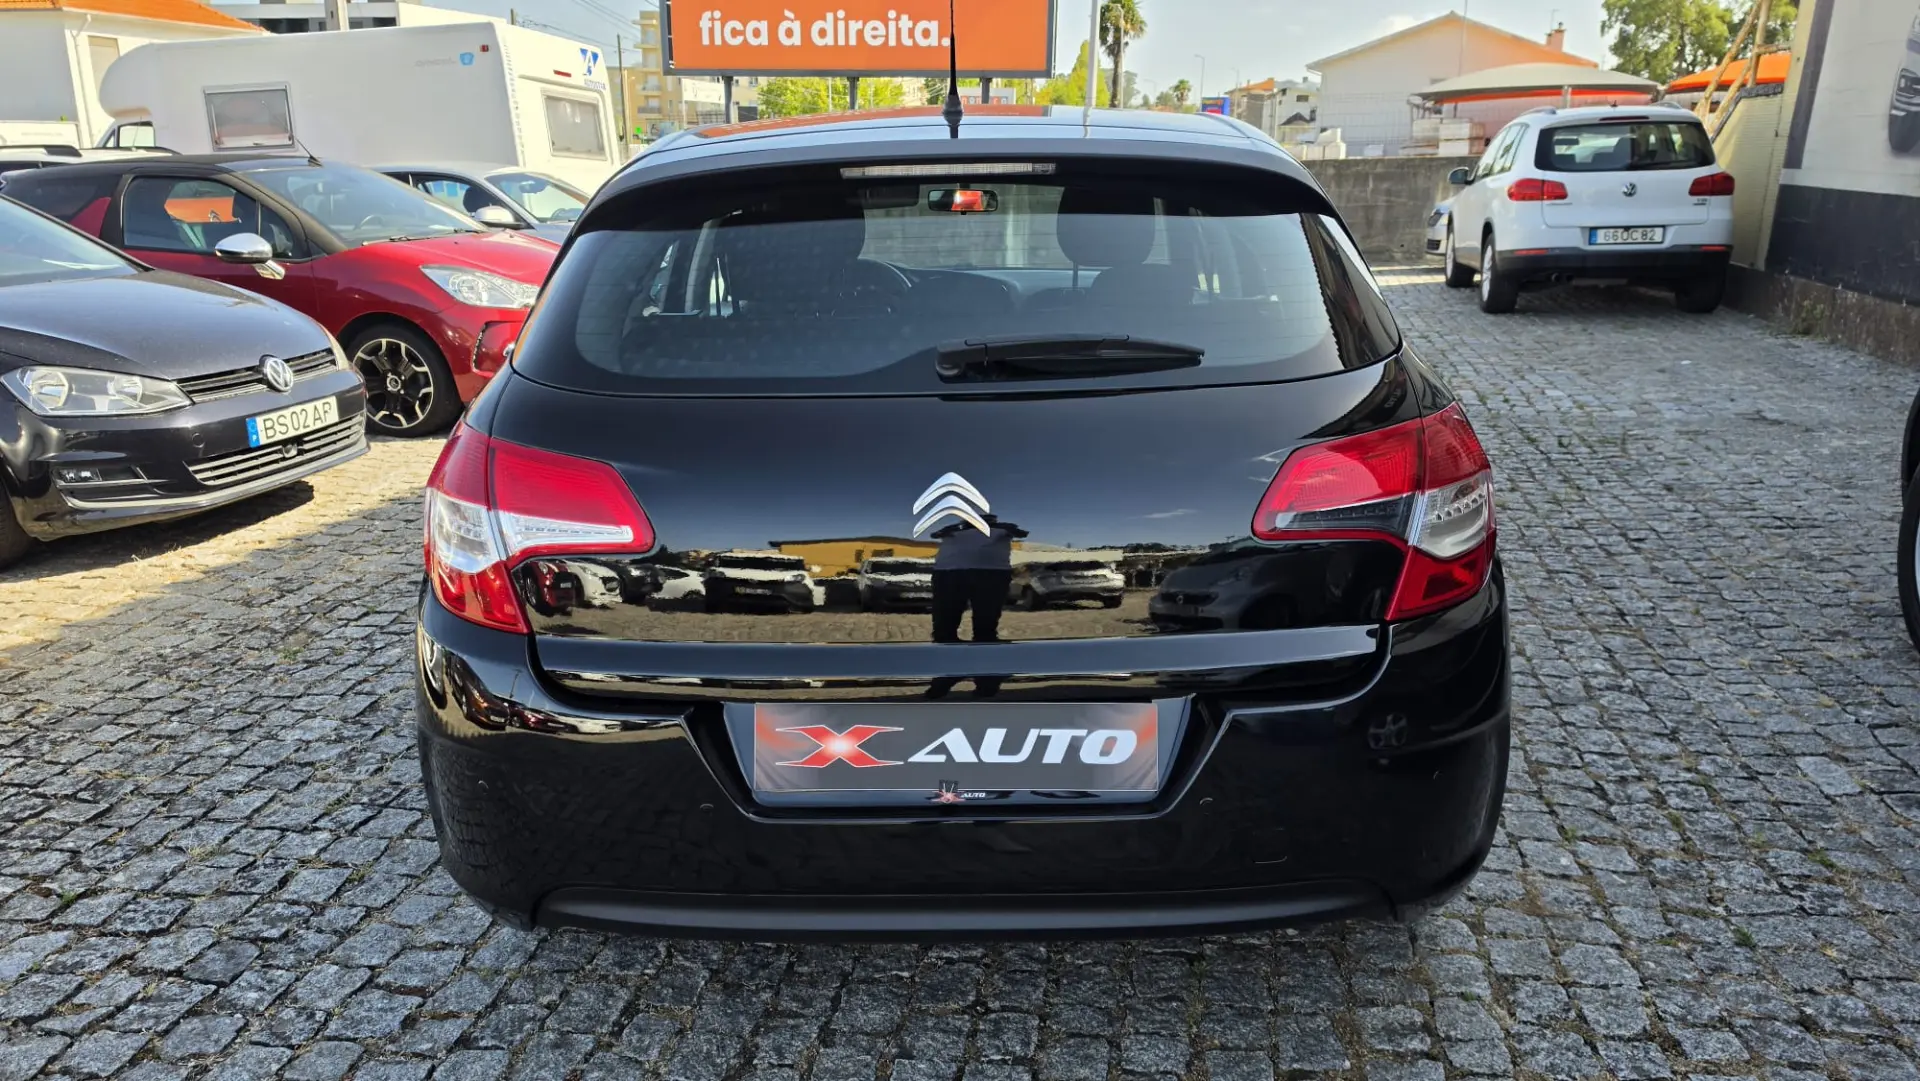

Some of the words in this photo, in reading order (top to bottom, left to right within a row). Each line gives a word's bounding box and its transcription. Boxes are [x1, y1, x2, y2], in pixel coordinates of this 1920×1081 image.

[699, 10, 769, 46] fica
[777, 9, 801, 46] à
[810, 10, 950, 47] direita.
[775, 724, 904, 768] X
[907, 727, 1138, 764] AUTO
